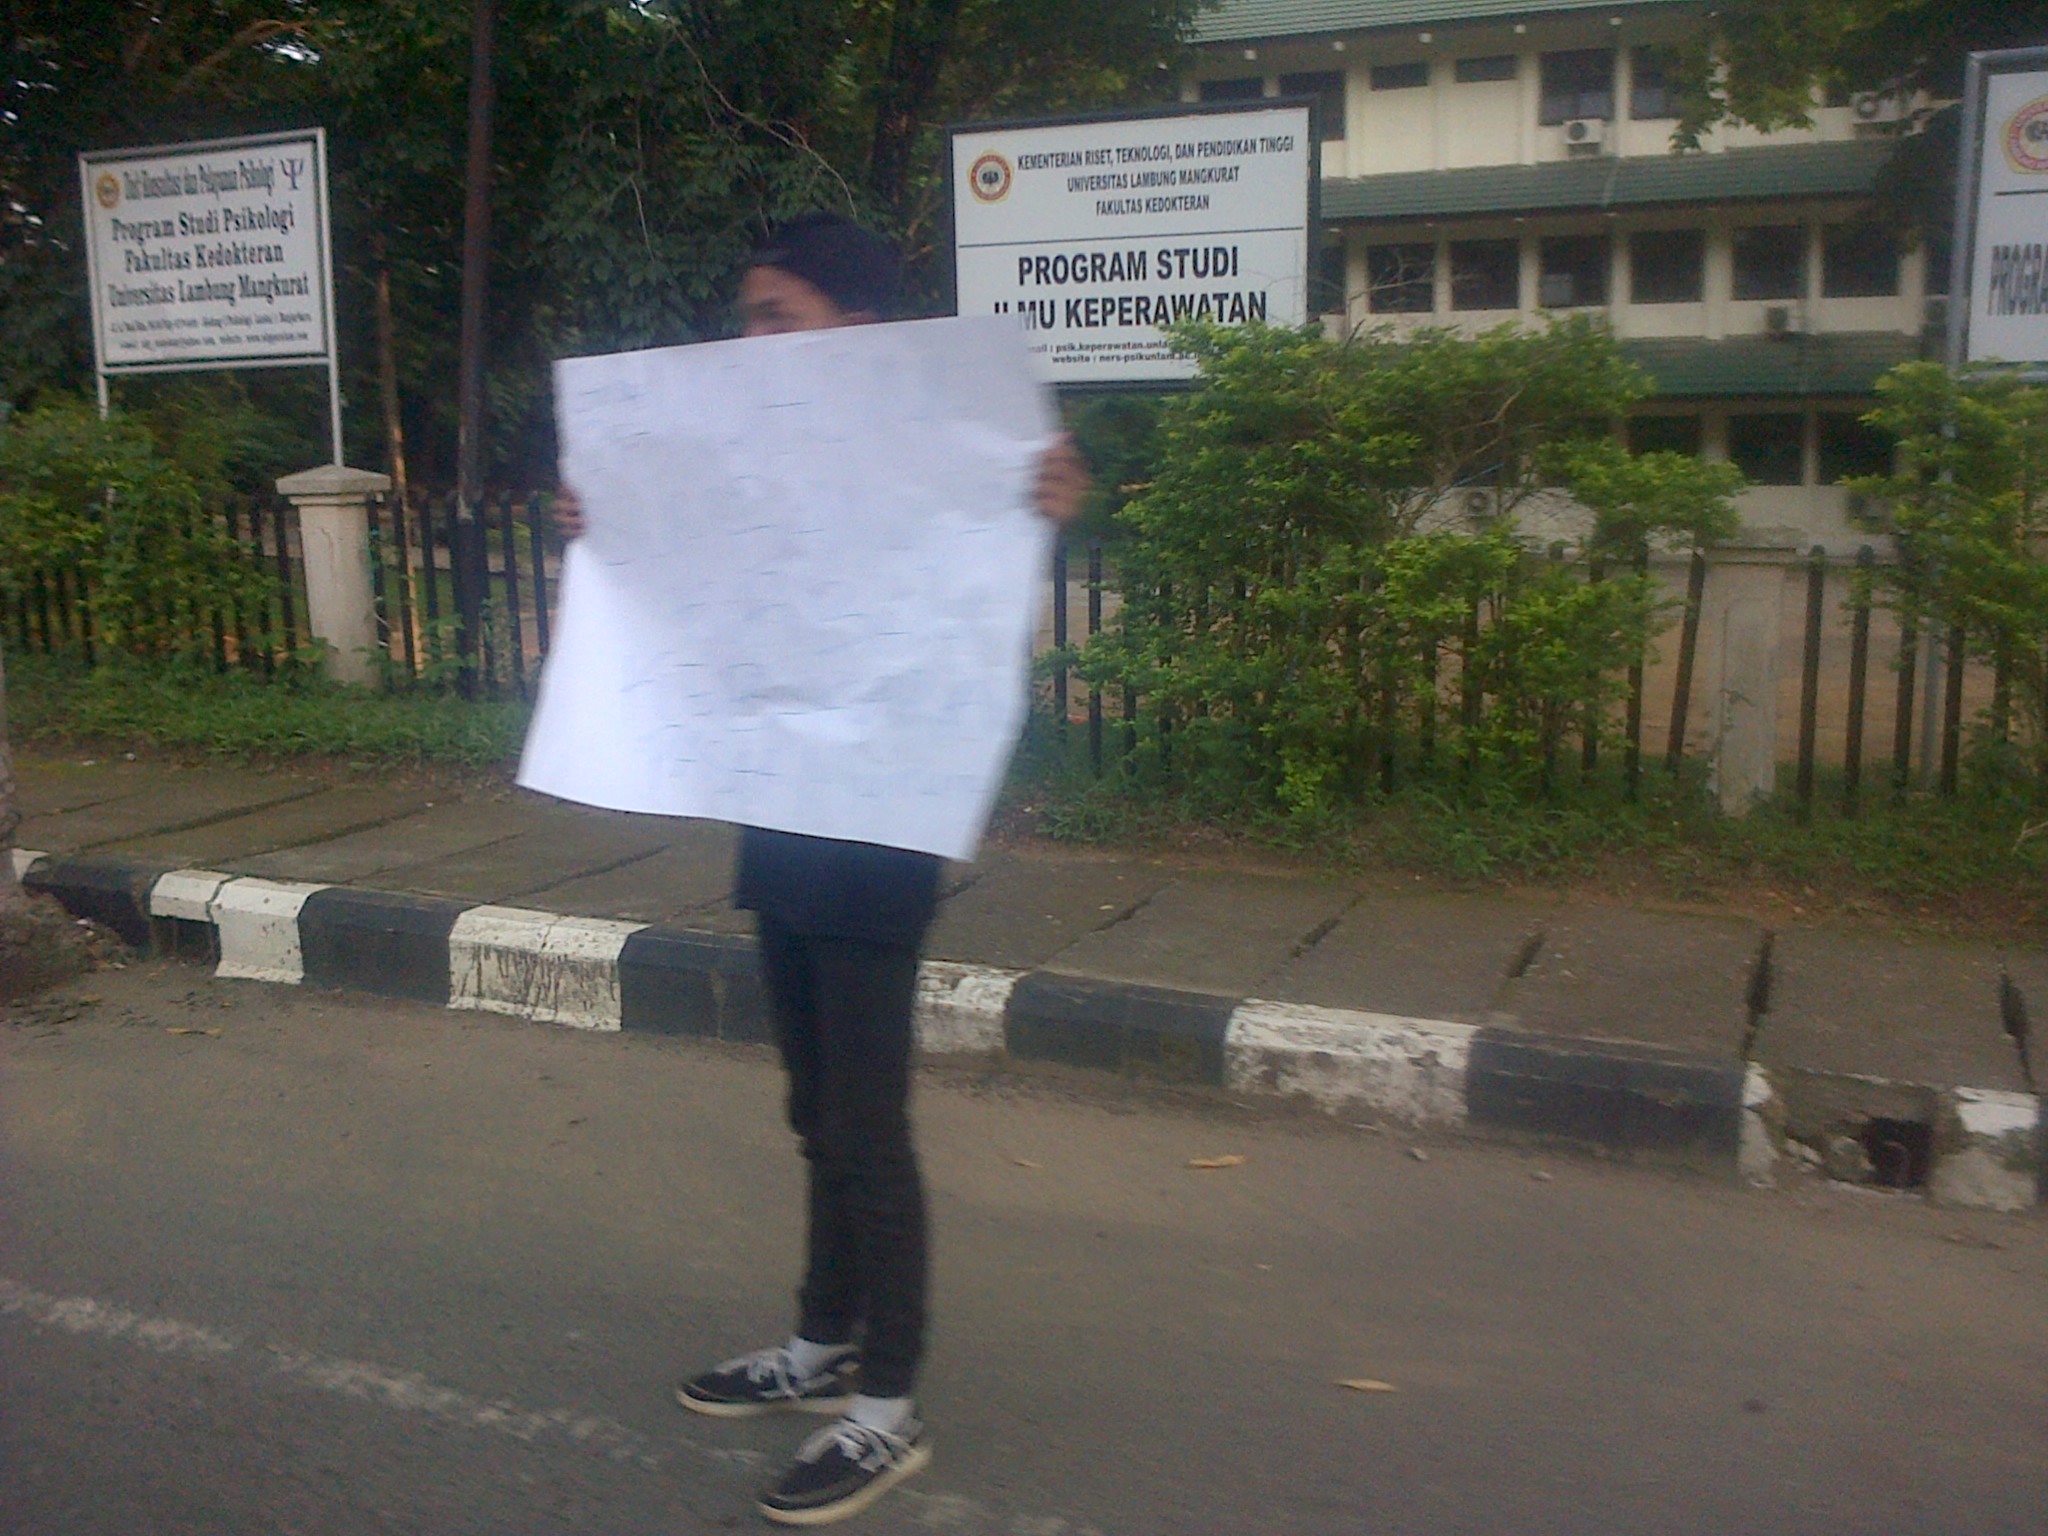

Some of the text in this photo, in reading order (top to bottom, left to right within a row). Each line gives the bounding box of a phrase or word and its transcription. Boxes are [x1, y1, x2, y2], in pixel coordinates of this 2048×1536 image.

[1018, 136, 1294, 169] KEMENTERIAN RISET, TEKNOLOGI, DAN PENDIDIKAN TINGGI
[1067, 166, 1240, 193] UNIVERSITAS LAMBUNG MANGKURAT
[1096, 195, 1210, 216] FAKULTAS KEDOKTERAN
[111, 202, 295, 246] Program Studi Psikologi
[124, 240, 284, 273] Fakultas Kedokteran
[1018, 246, 1238, 286] PROGRAM STUDI
[178, 278, 236, 306] Lambung
[238, 271, 309, 304] Mangkurat
[1065, 291, 1267, 329] KEPERAWATAN
